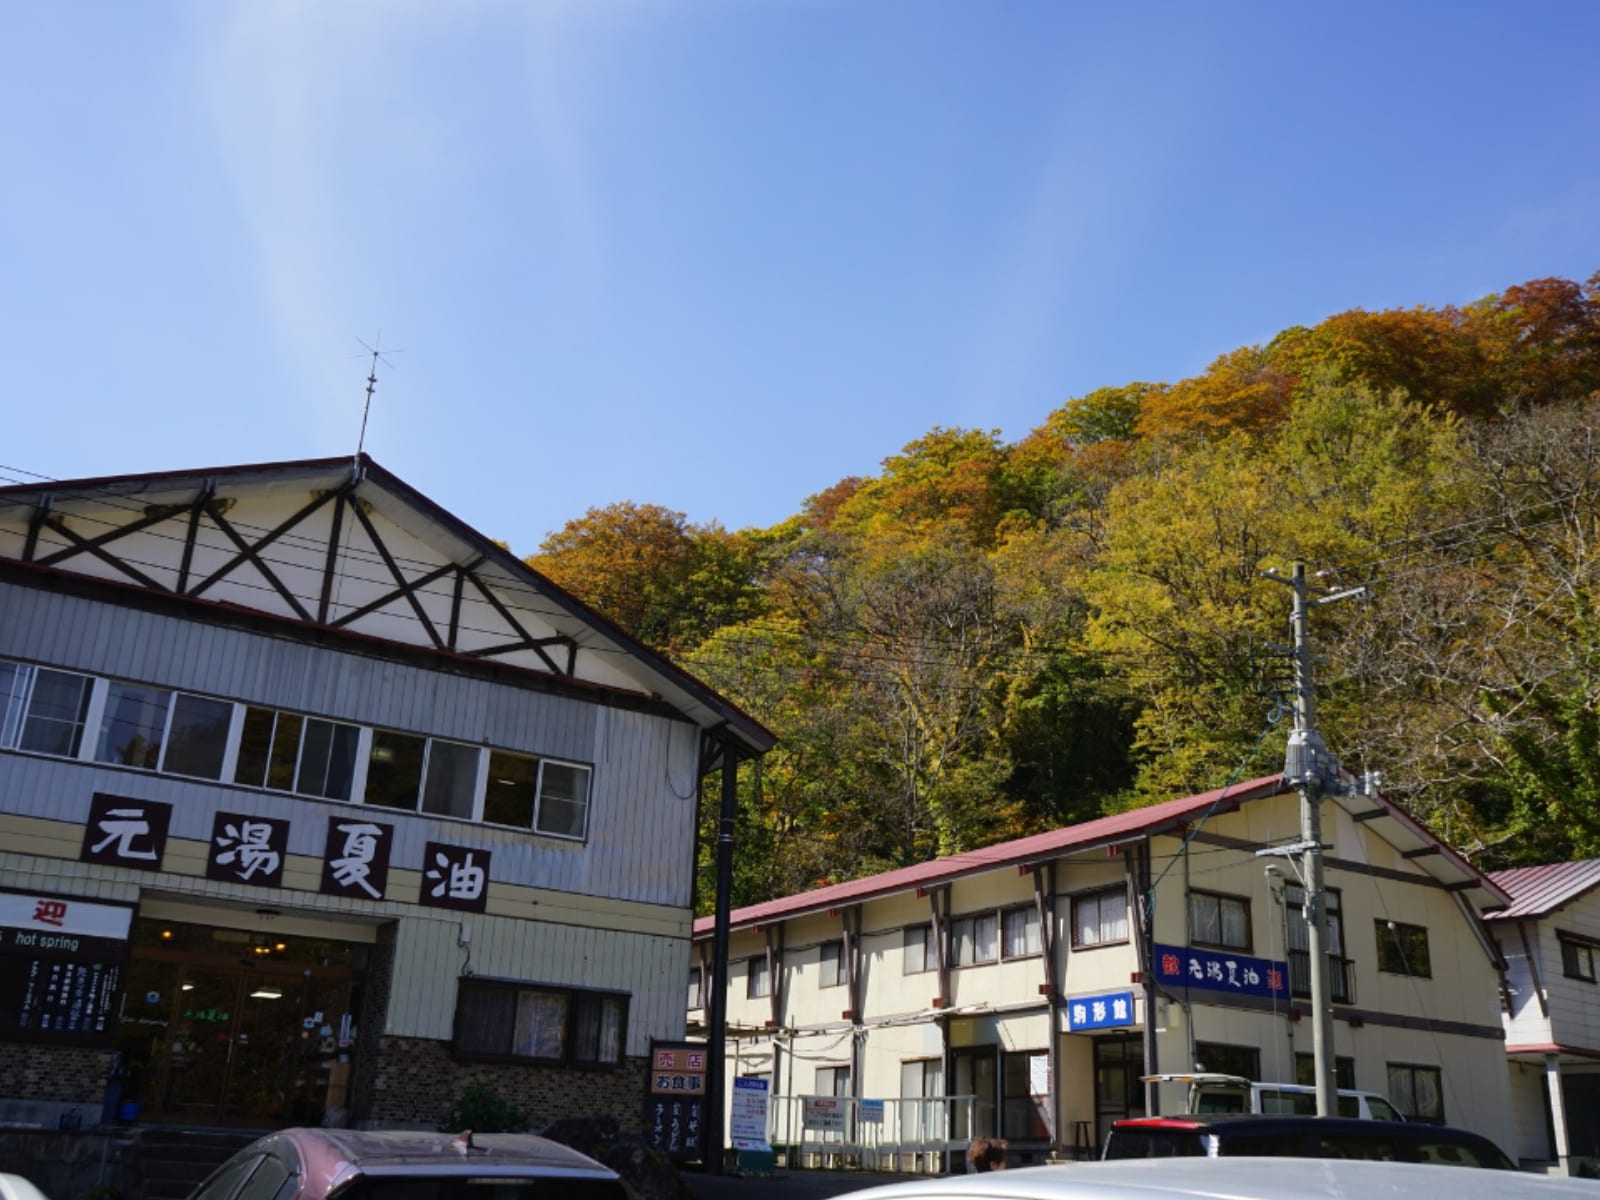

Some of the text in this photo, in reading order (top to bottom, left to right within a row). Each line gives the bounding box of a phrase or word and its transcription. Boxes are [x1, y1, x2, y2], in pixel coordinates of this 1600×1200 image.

[91, 808, 484, 900] 元湯夏油
[33, 900, 67, 925] 迎
[16, 931, 37, 945] hot
[40, 936, 79, 952] spring
[658, 1052, 703, 1068] 売店
[656, 1074, 701, 1089] お食事
[652, 1103, 664, 1145] ラーメン
